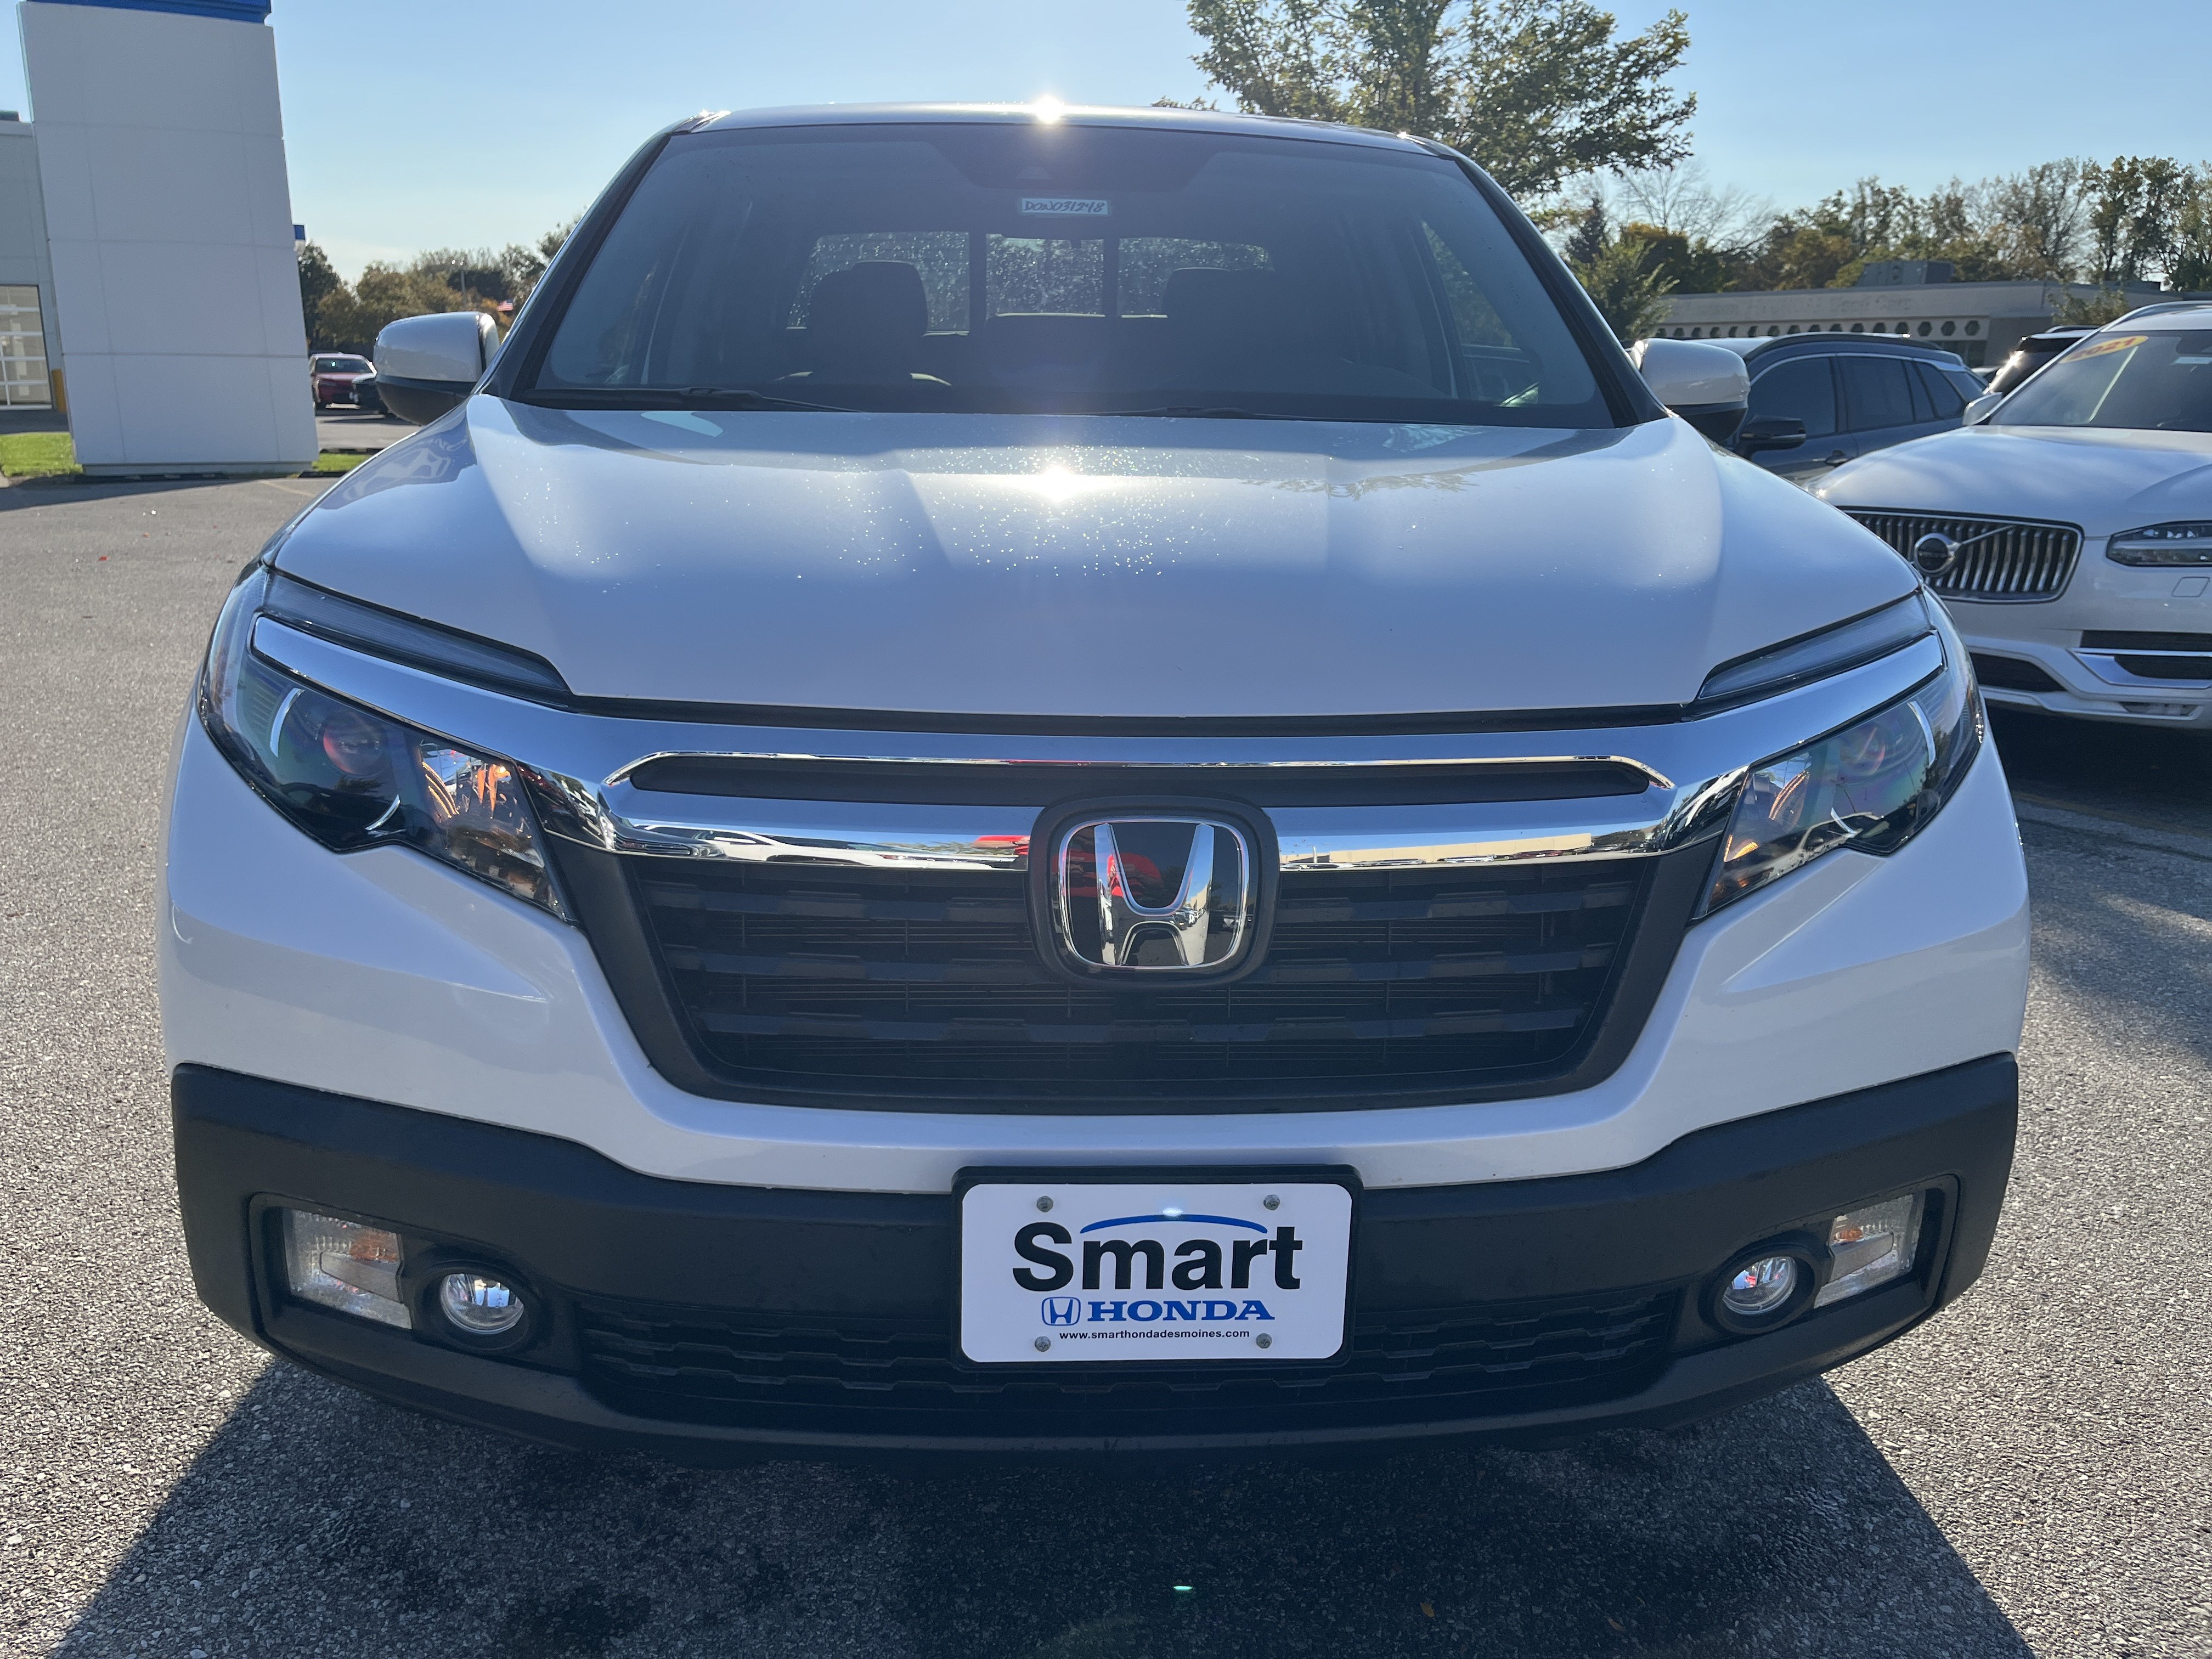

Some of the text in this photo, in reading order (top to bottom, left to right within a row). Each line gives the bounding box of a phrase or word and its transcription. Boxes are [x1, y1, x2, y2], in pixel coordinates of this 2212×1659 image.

[1013, 1222, 1303, 1292] Smart
[1087, 1300, 1276, 1322] HONDA
[1059, 1329, 1250, 1339] www.smarthondadesmoines.com
